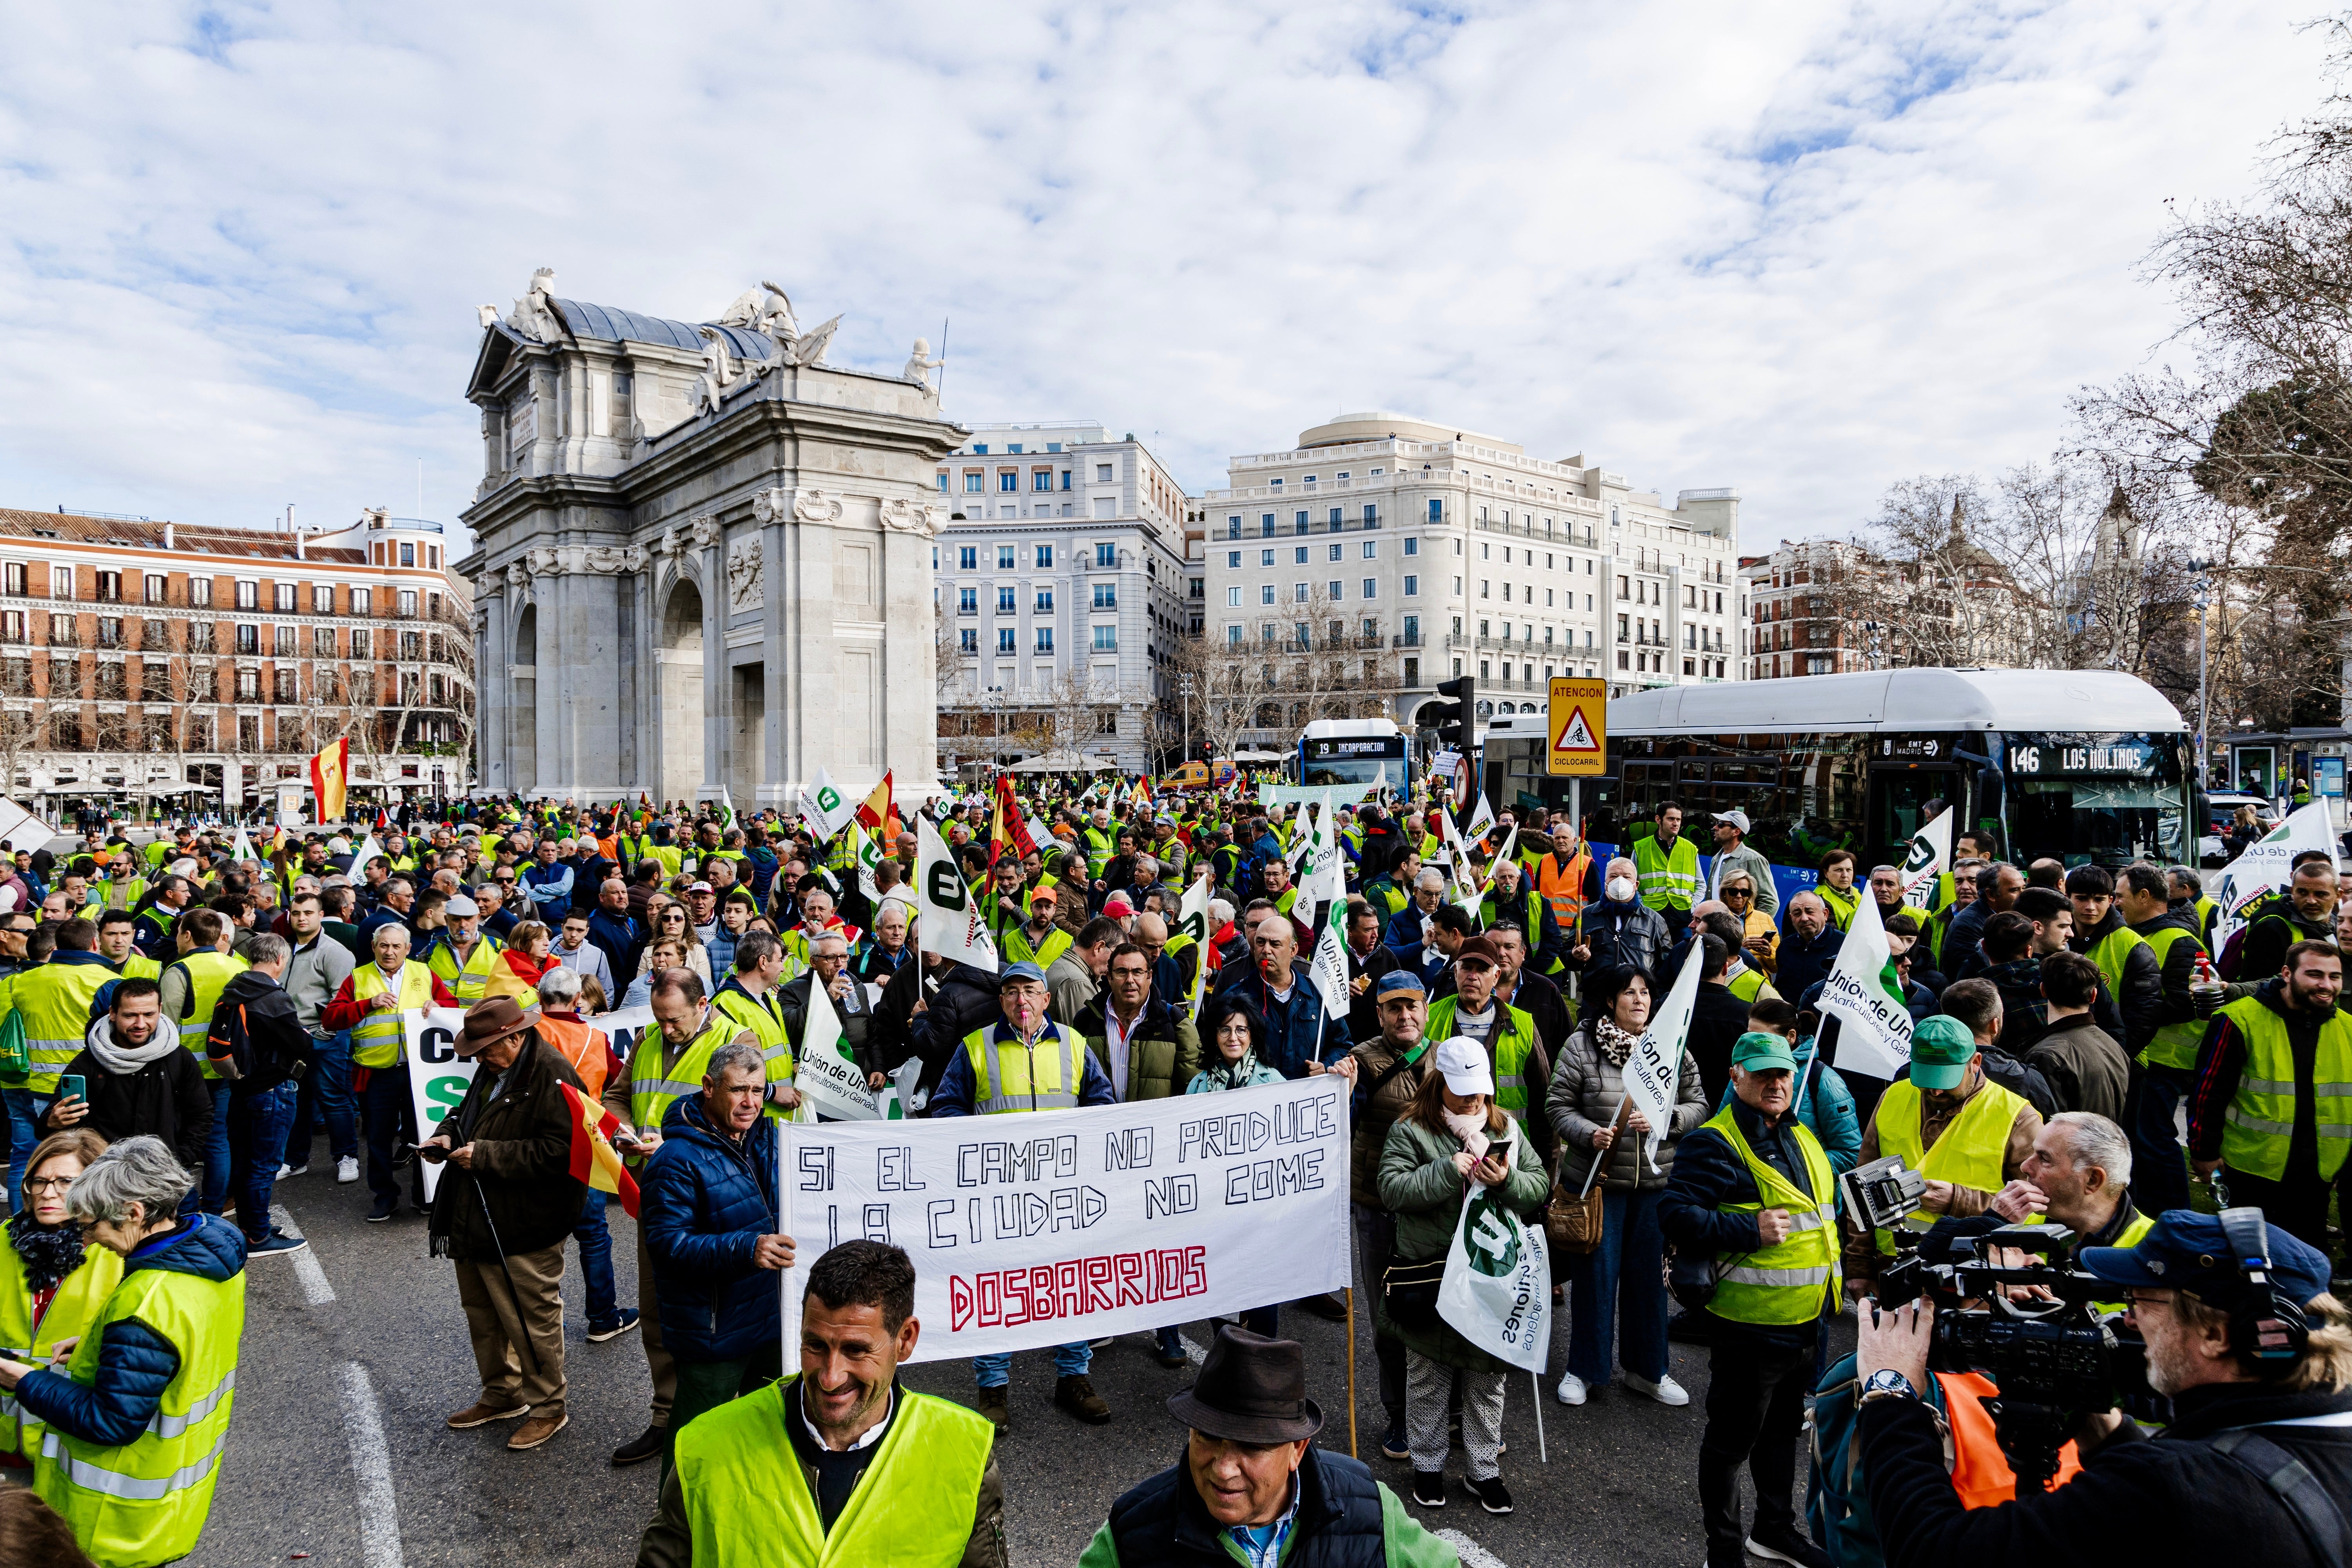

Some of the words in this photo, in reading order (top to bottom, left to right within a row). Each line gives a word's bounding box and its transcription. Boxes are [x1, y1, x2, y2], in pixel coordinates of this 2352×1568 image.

[1553, 687, 1602, 698] ATENCION
[1319, 743, 1329, 754] 19
[1338, 742, 1385, 753] INCORPORACION
[2010, 747, 2039, 772] 146
[2063, 748, 2086, 769] LOS
[2090, 748, 2141, 769] MOLINOS
[803, 795, 814, 807] nión
[812, 805, 818, 813] de
[817, 811, 831, 833] Uniones
[1472, 820, 1490, 836] UCCL
[1918, 873, 1928, 882] DE
[137, 929, 145, 937] 2
[965, 916, 976, 947] UNION
[1316, 956, 1341, 1005] Ganaderos
[1321, 938, 1349, 1001] Uniones
[1869, 1000, 1888, 1021] de
[1883, 1033, 1891, 1043] y
[802, 1047, 829, 1073] Unión
[829, 1064, 847, 1081] de
[797, 1065, 809, 1076] de
[808, 1069, 843, 1094] Agricultores
[841, 1089, 850, 1098] y
[799, 1147, 834, 1191] SI
[877, 1147, 926, 1191] EL
[957, 1135, 1077, 1187] CAMPO
[1105, 1126, 1154, 1172] NO
[1179, 1093, 1336, 1163] PRODUCE
[927, 1185, 1107, 1249] CIUDAD
[1145, 1174, 1198, 1220] NO
[1225, 1148, 1325, 1205] COME
[949, 1245, 1207, 1332] DOSBARRIOS
